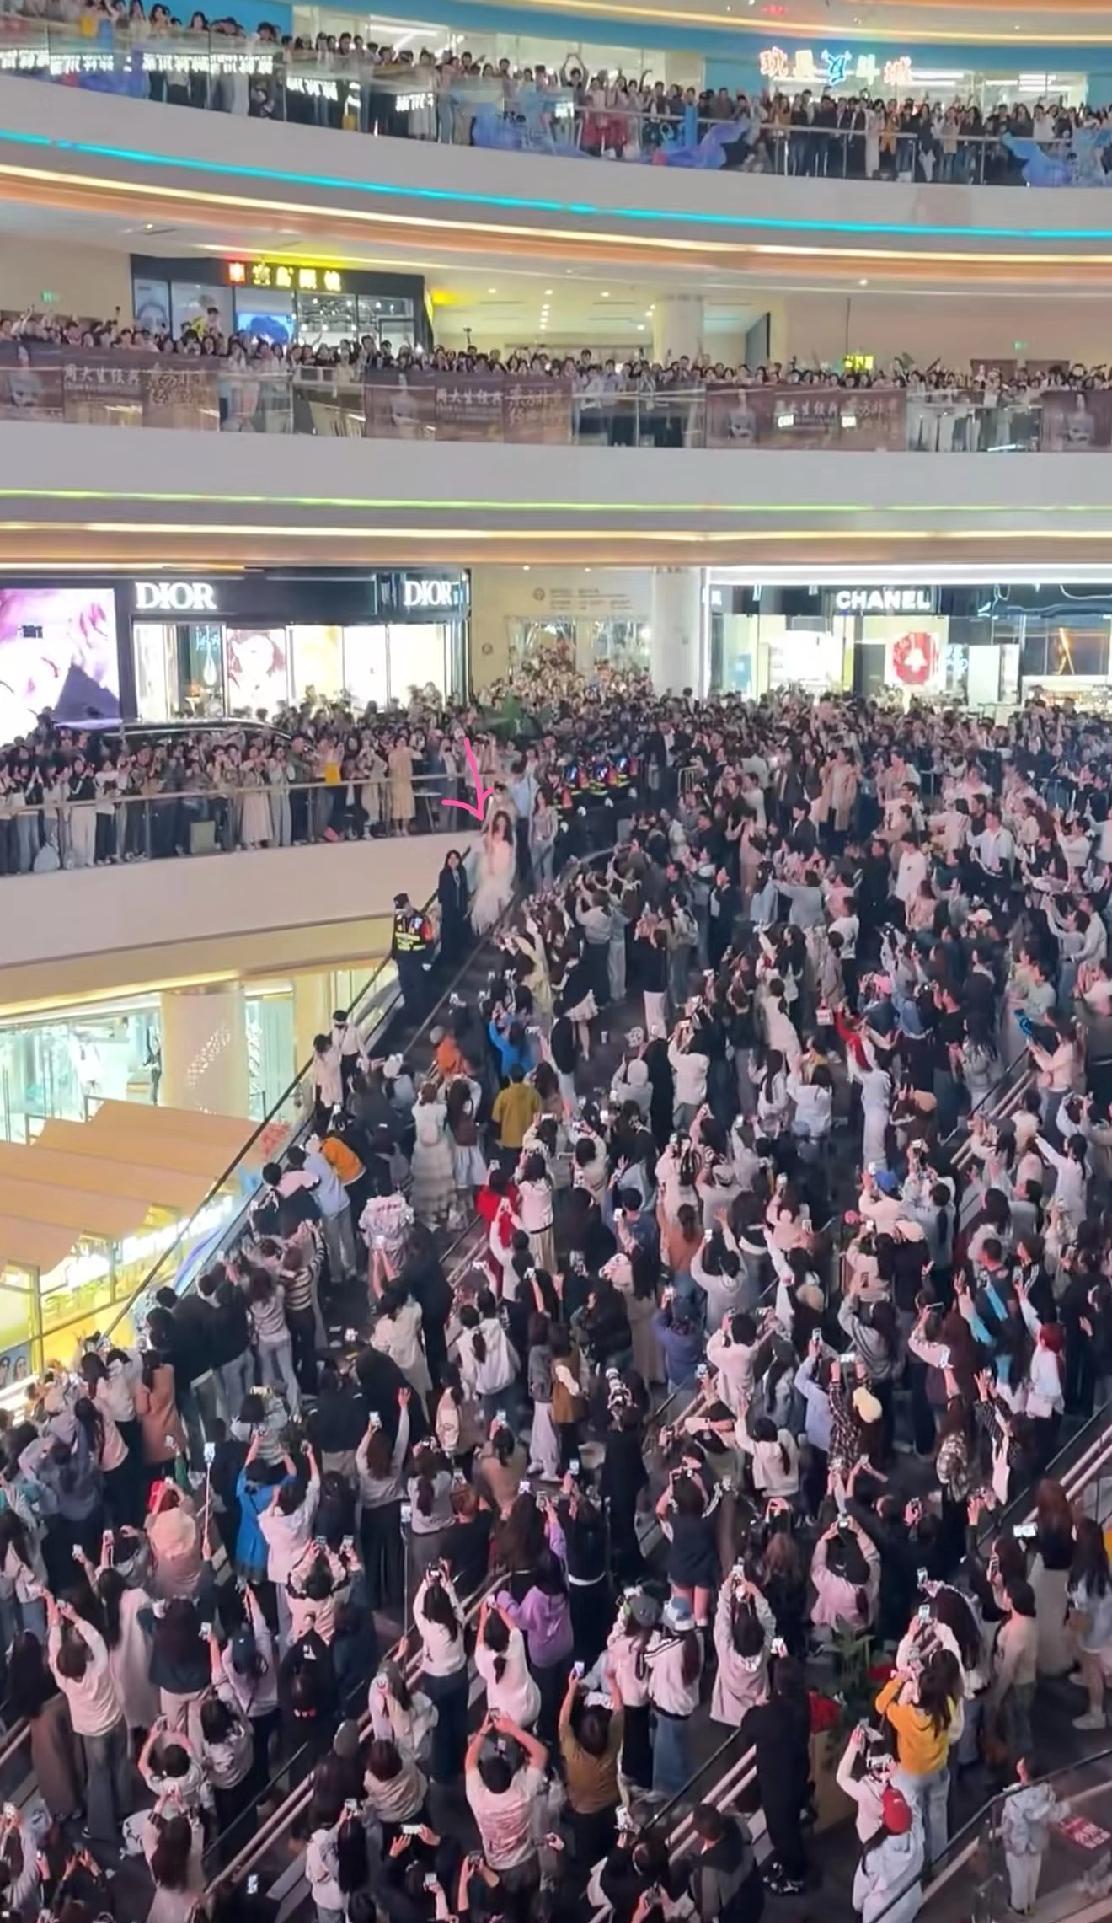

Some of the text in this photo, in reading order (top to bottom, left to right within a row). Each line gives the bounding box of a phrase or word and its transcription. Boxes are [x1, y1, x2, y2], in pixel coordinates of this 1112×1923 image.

[135, 582, 218, 610] DIOR
[404, 580, 452, 606] DIOR
[836, 590, 931, 610] CHANEL
